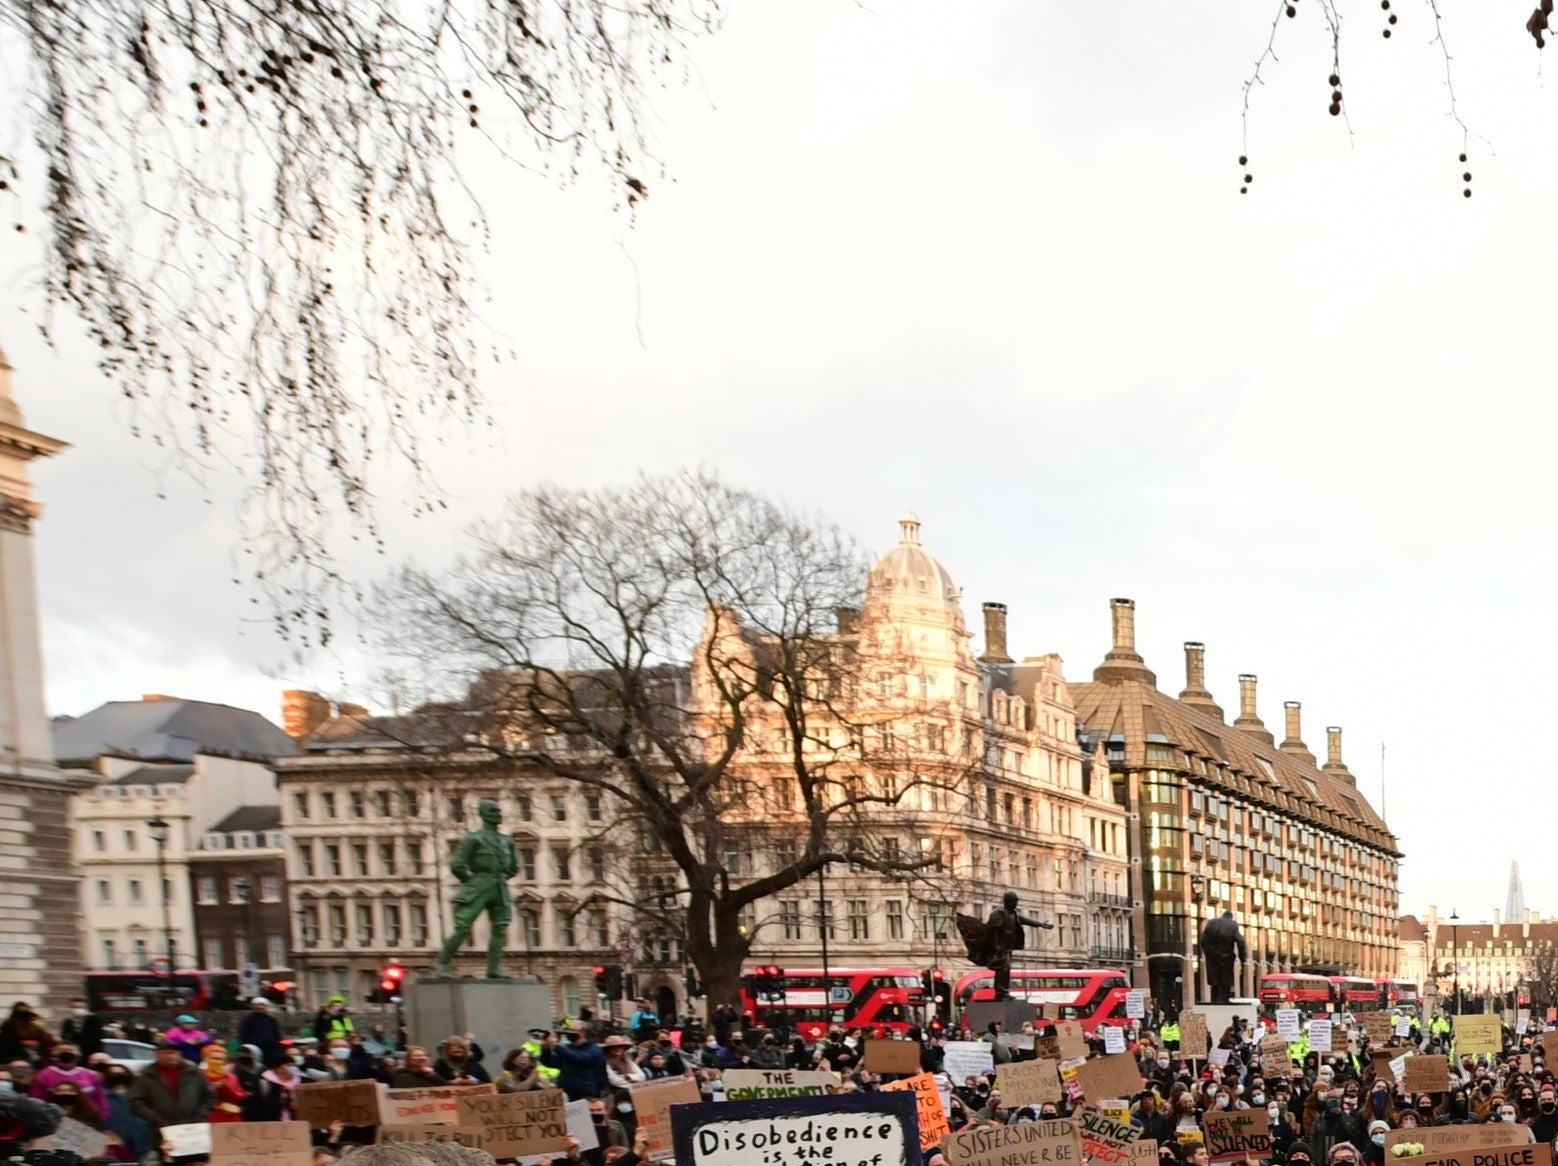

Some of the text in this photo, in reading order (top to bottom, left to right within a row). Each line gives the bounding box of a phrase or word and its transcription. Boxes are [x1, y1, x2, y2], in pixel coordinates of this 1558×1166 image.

[762, 1072, 794, 1084] THE
[461, 1098, 511, 1115] YOUR
[481, 1108, 559, 1126] WILL NOT
[932, 1110, 943, 1122] OF
[539, 1122, 568, 1138] YOU
[1078, 1112, 1140, 1144] SILENCE
[698, 1121, 893, 1157] Disobedience
[956, 1120, 1073, 1160] SISTERS UNITED
[1080, 1131, 1126, 1151] WILL NOT
[763, 1146, 834, 1164] is the
[1055, 1144, 1072, 1161] BE
